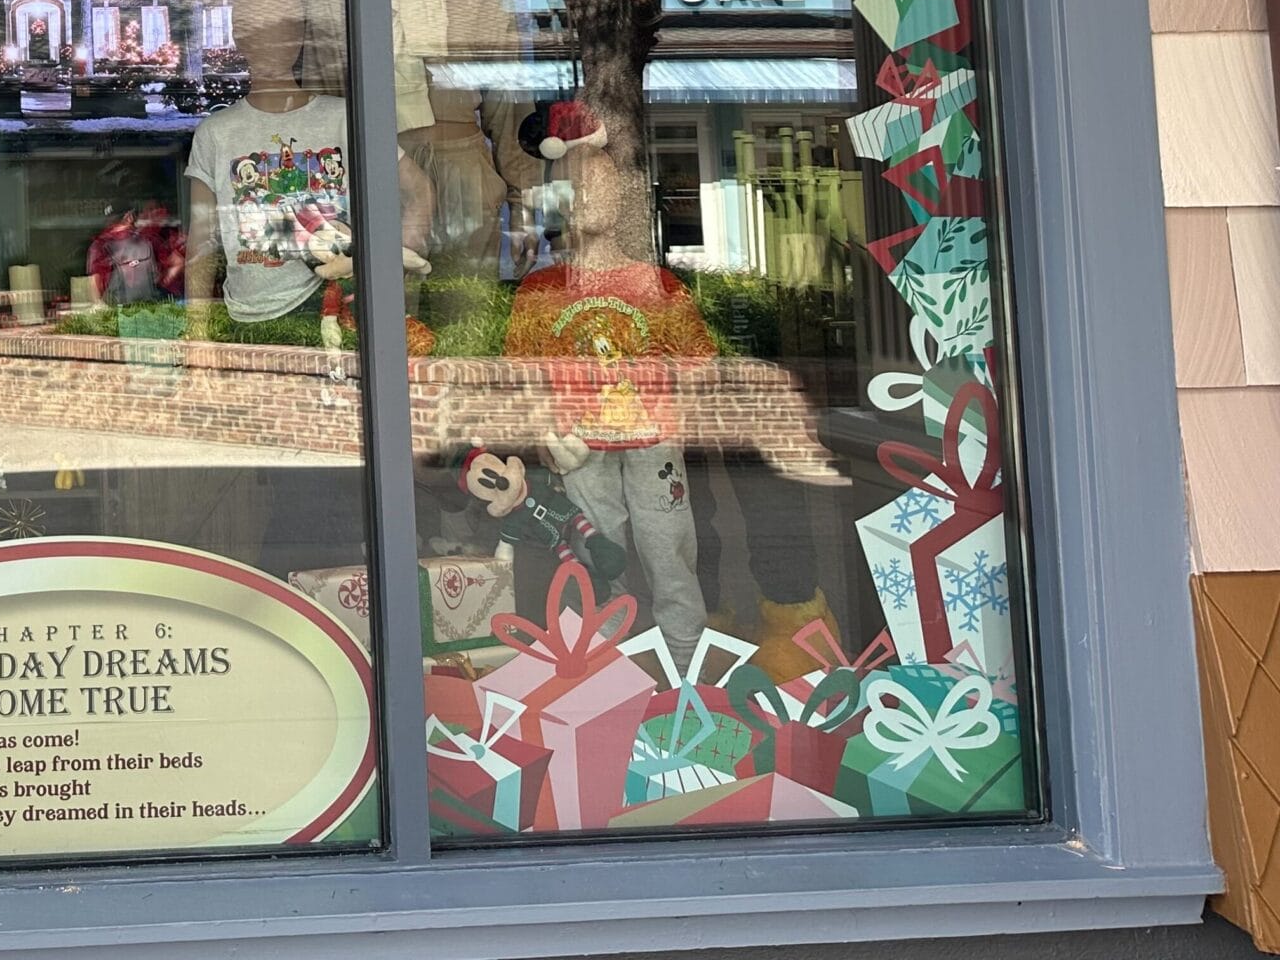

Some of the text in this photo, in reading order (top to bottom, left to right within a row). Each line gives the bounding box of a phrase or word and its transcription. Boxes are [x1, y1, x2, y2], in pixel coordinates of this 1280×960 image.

[155, 622, 173, 639] 6:
[83, 647, 232, 679] DREAMS
[80, 685, 175, 716] TRUE
[22, 729, 80, 748] come!
[6, 756, 47, 776] leap
[52, 754, 102, 772] from
[107, 753, 154, 770] their
[159, 752, 204, 769] beds
[14, 779, 92, 801] brought
[22, 803, 110, 823] dreamed
[115, 802, 135, 820] in
[139, 801, 187, 818] their
